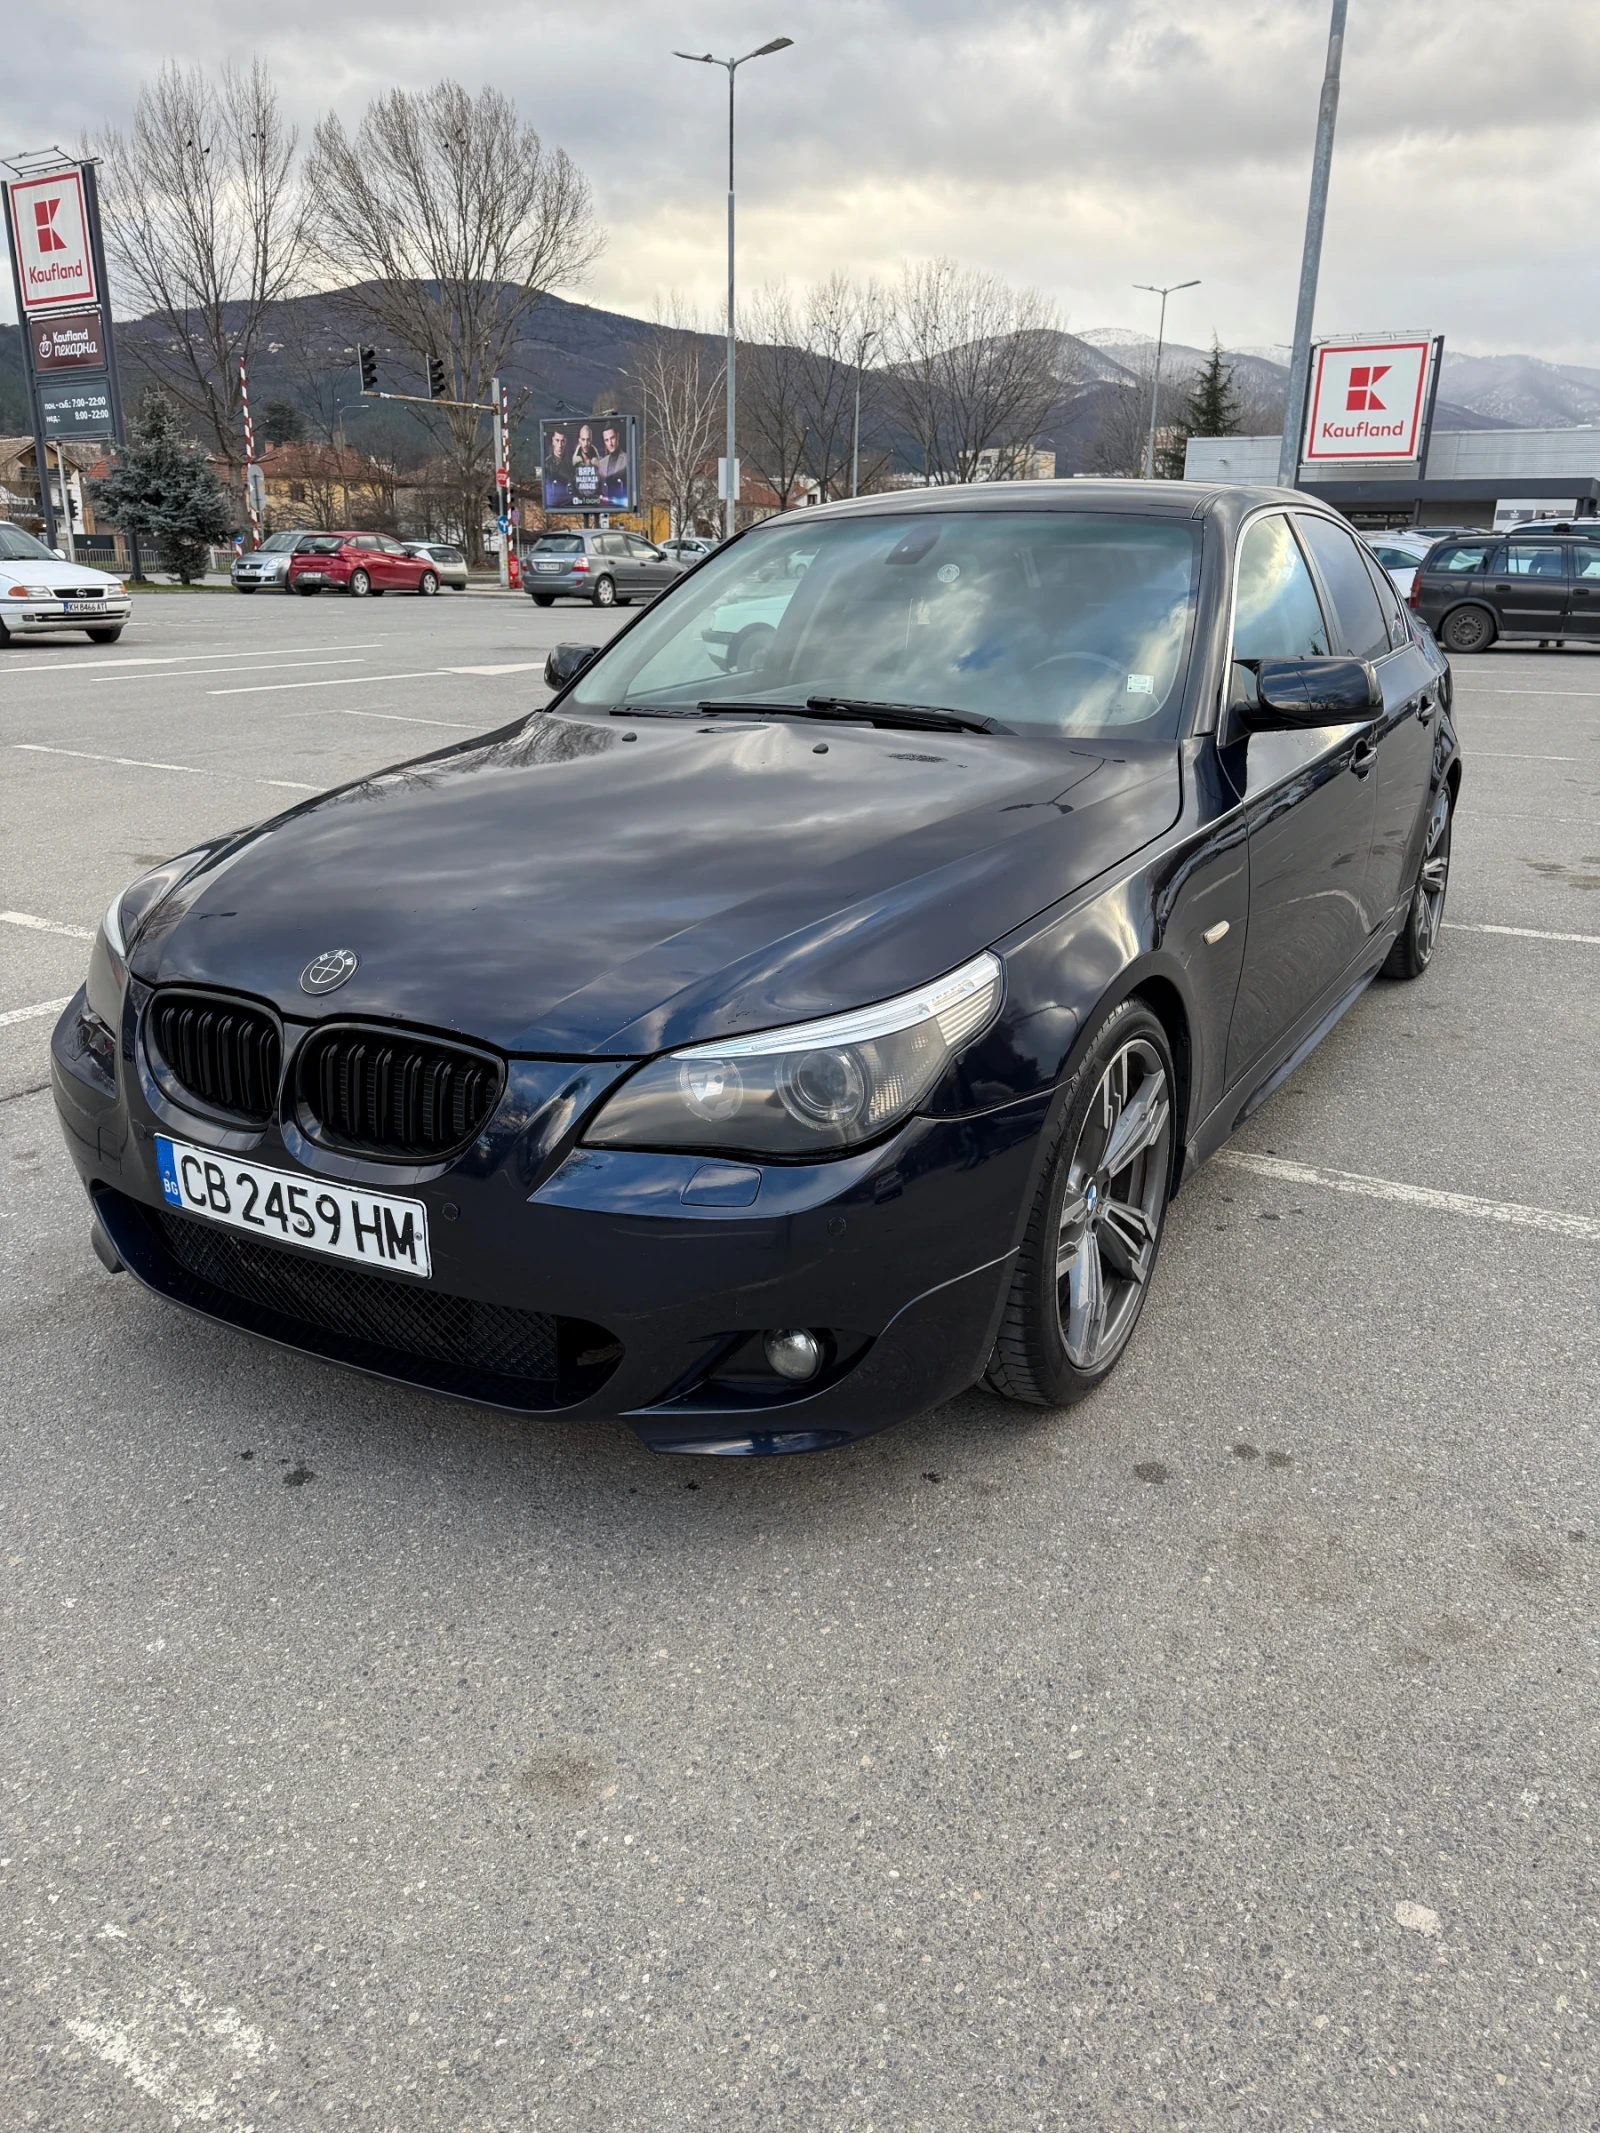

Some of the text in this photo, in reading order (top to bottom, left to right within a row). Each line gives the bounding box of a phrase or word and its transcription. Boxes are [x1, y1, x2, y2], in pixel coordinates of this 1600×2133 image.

[29, 259, 83, 284] Kaufland
[52, 328, 89, 344] Kaufland
[54, 341, 98, 358] пекарна
[1322, 420, 1404, 438] Kaufland
[163, 1177, 180, 1196] BG
[236, 1172, 342, 1247] 2459
[351, 1200, 418, 1266] HM
